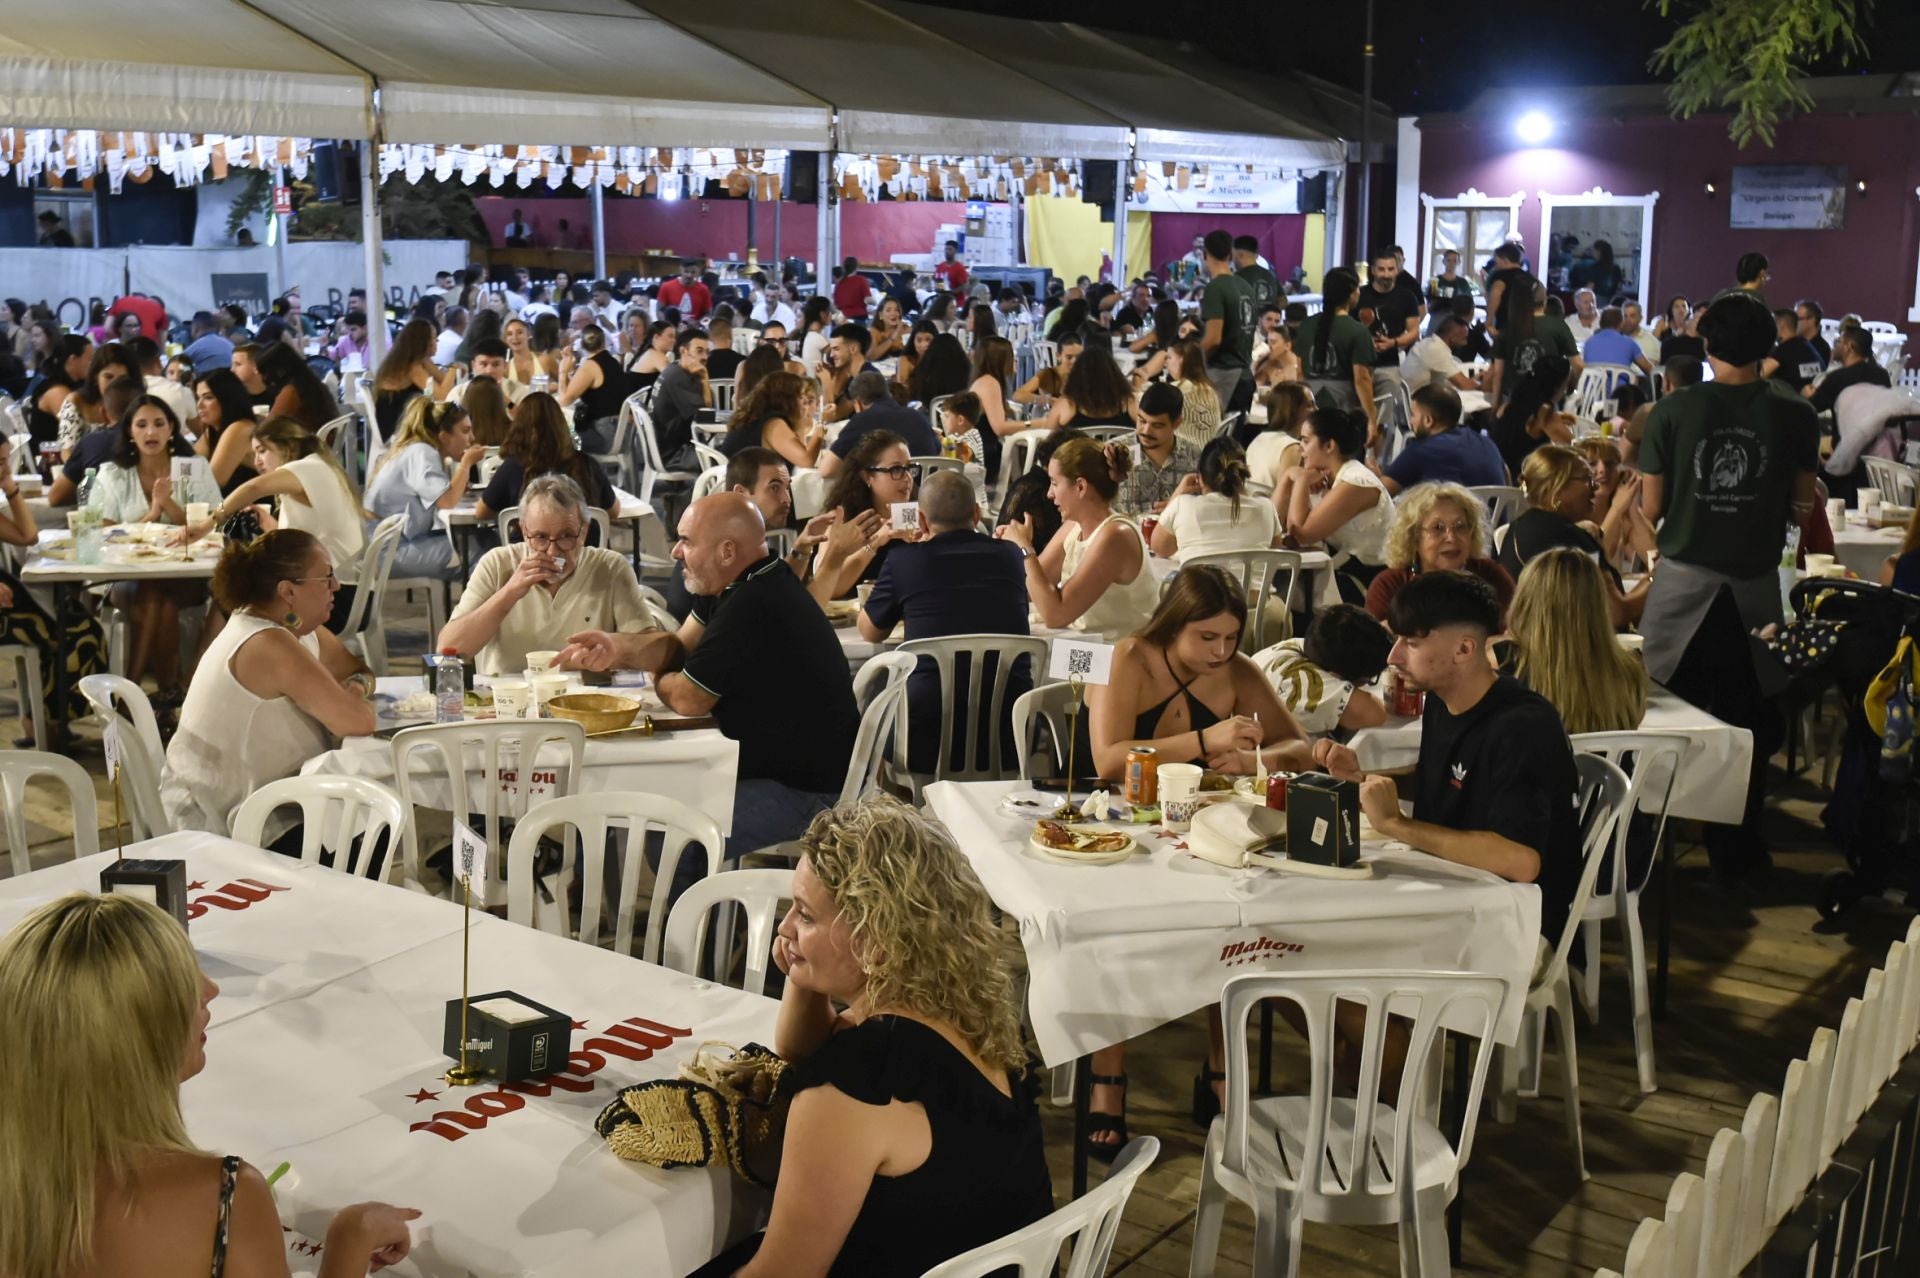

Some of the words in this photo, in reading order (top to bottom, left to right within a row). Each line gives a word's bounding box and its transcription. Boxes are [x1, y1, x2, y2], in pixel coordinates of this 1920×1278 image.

[1218, 186, 1253, 194] Murcia
[482, 768, 557, 785] aou
[1219, 936, 1305, 962] Mahou
